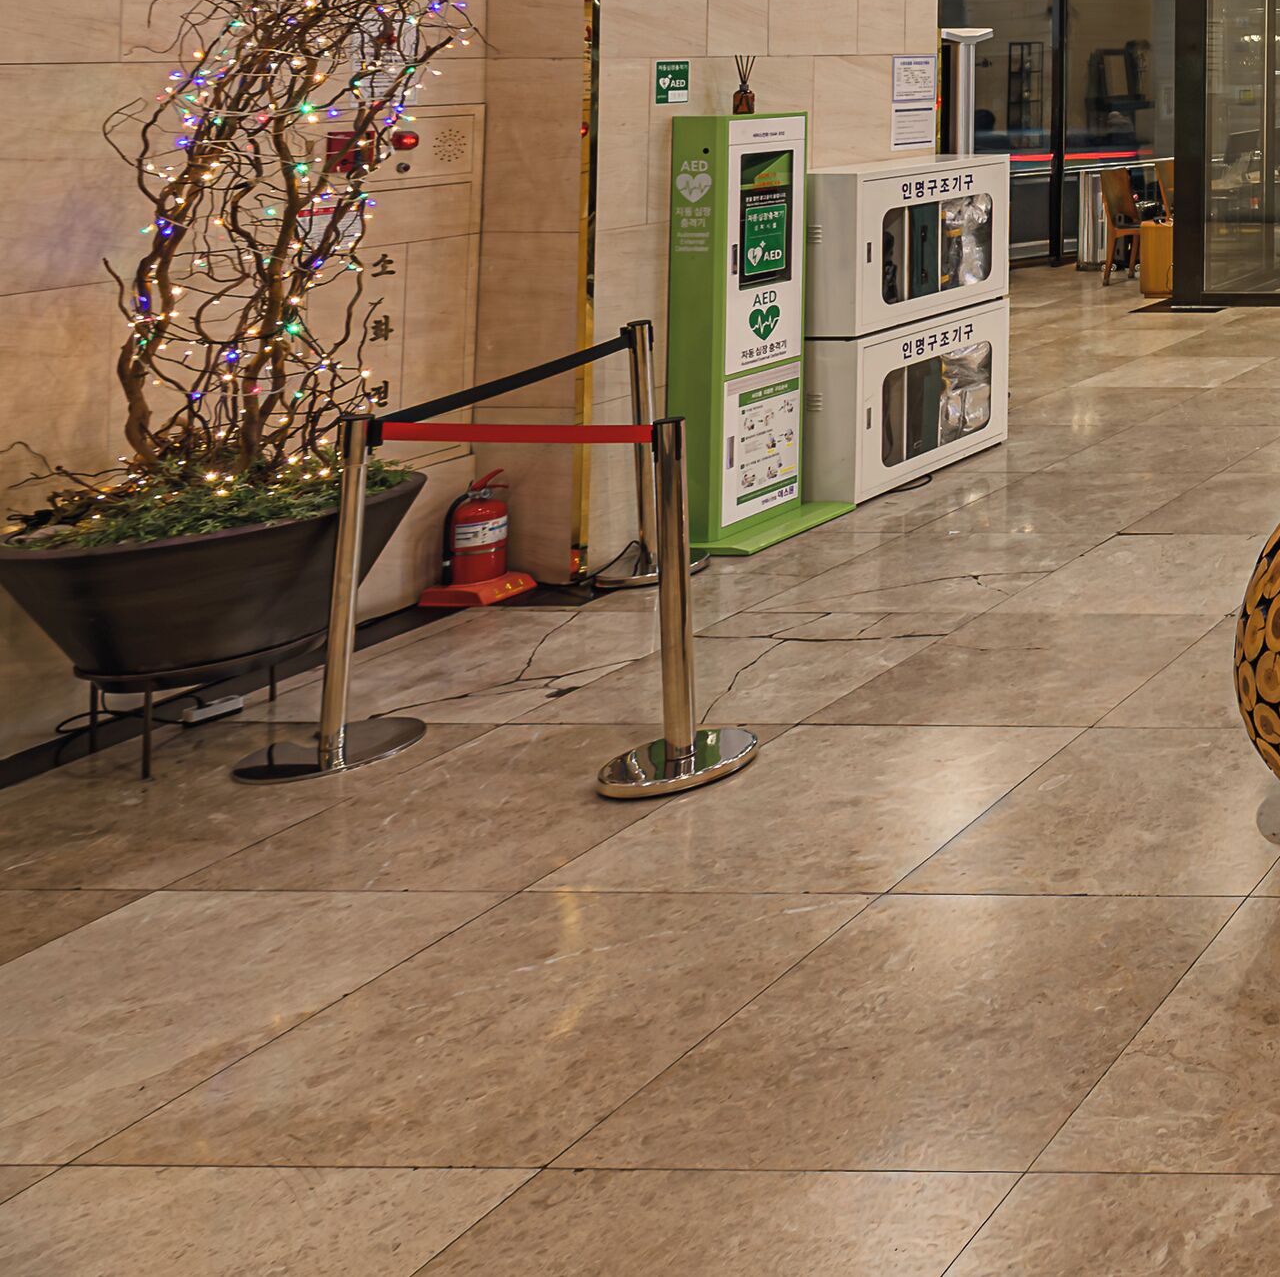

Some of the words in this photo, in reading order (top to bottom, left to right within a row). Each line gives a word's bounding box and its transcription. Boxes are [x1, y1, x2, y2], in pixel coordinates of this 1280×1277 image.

[670, 79, 686, 88] AED
[681, 160, 709, 172] AED
[902, 174, 974, 200] 인명구조기구
[763, 250, 783, 262] AED
[752, 290, 777, 307] AED
[741, 348, 755, 359] 자동
[755, 344, 768, 356] 심장
[769, 339, 787, 353] 충격기
[902, 323, 974, 360] 인명구조기구
